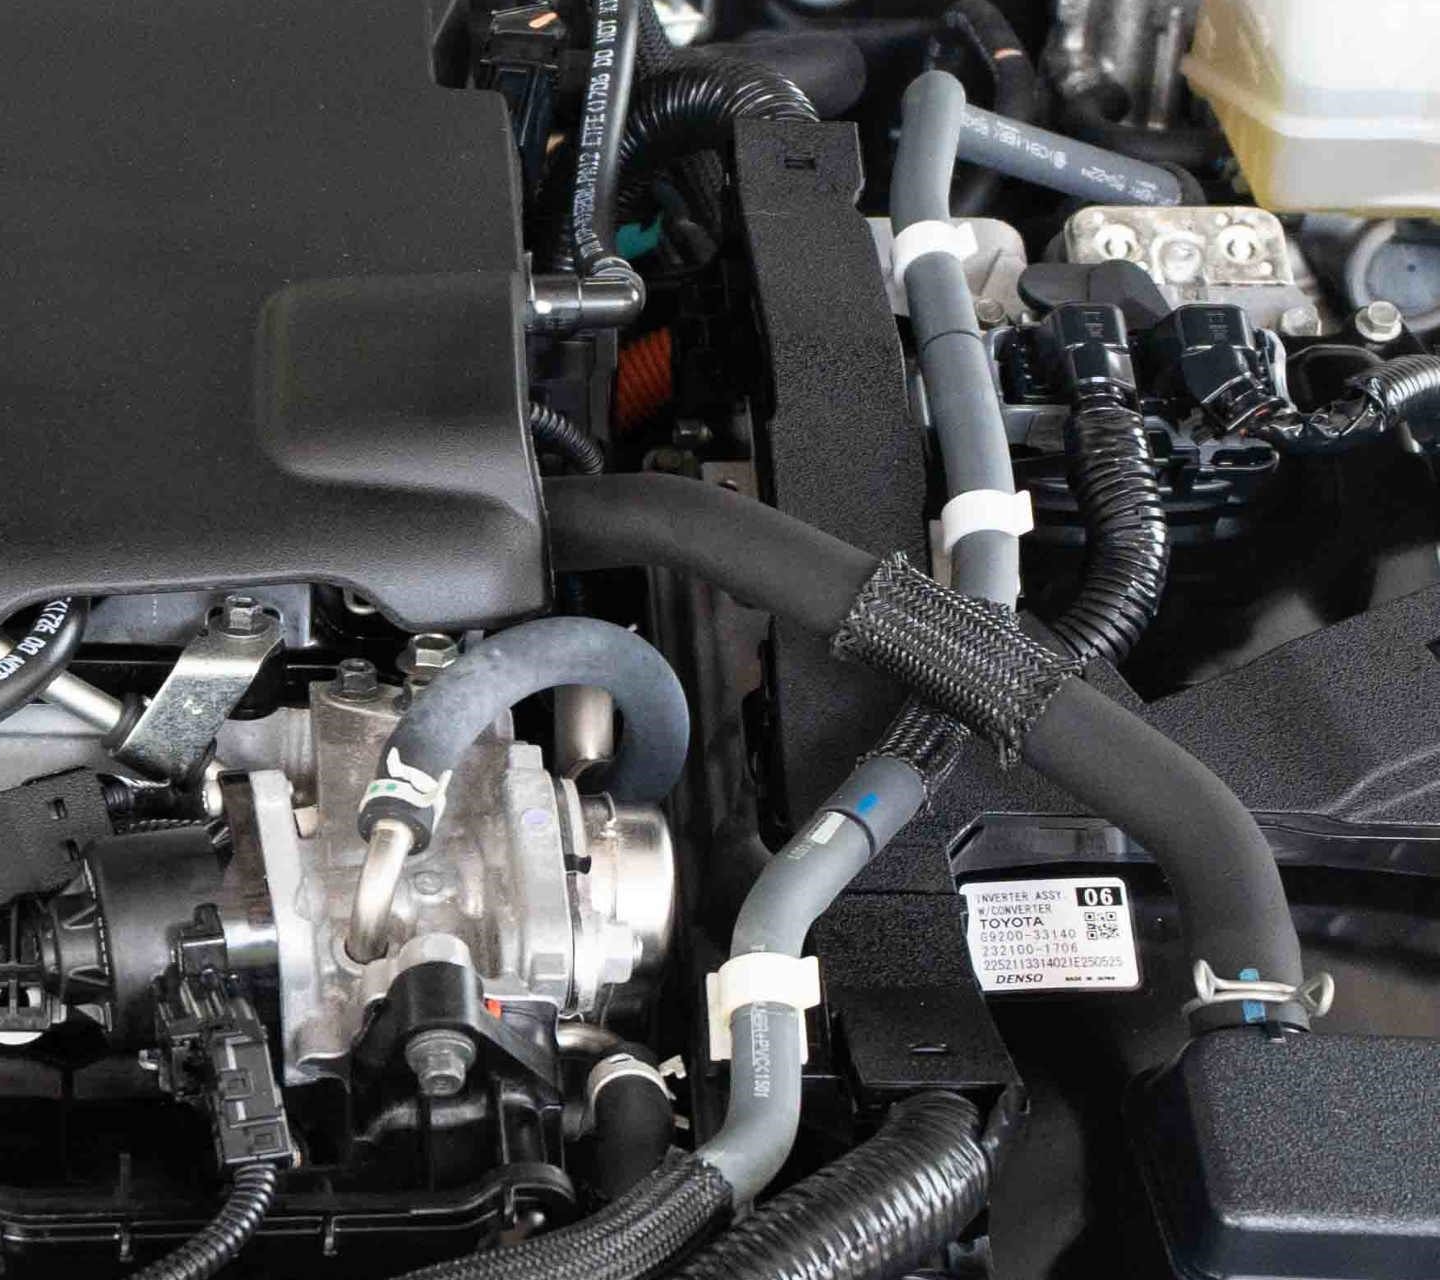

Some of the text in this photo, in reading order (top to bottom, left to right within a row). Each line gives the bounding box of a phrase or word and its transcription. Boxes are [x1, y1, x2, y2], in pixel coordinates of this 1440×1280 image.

[17, 636, 47, 656] DO
[1083, 887, 1114, 907] 06
[977, 904, 1052, 917] W/CONVERTER
[980, 916, 1045, 930] TOYOTA
[980, 928, 1077, 944] G9200-33140
[982, 942, 1079, 956] 232100-1706
[995, 972, 1044, 985] DENSO
